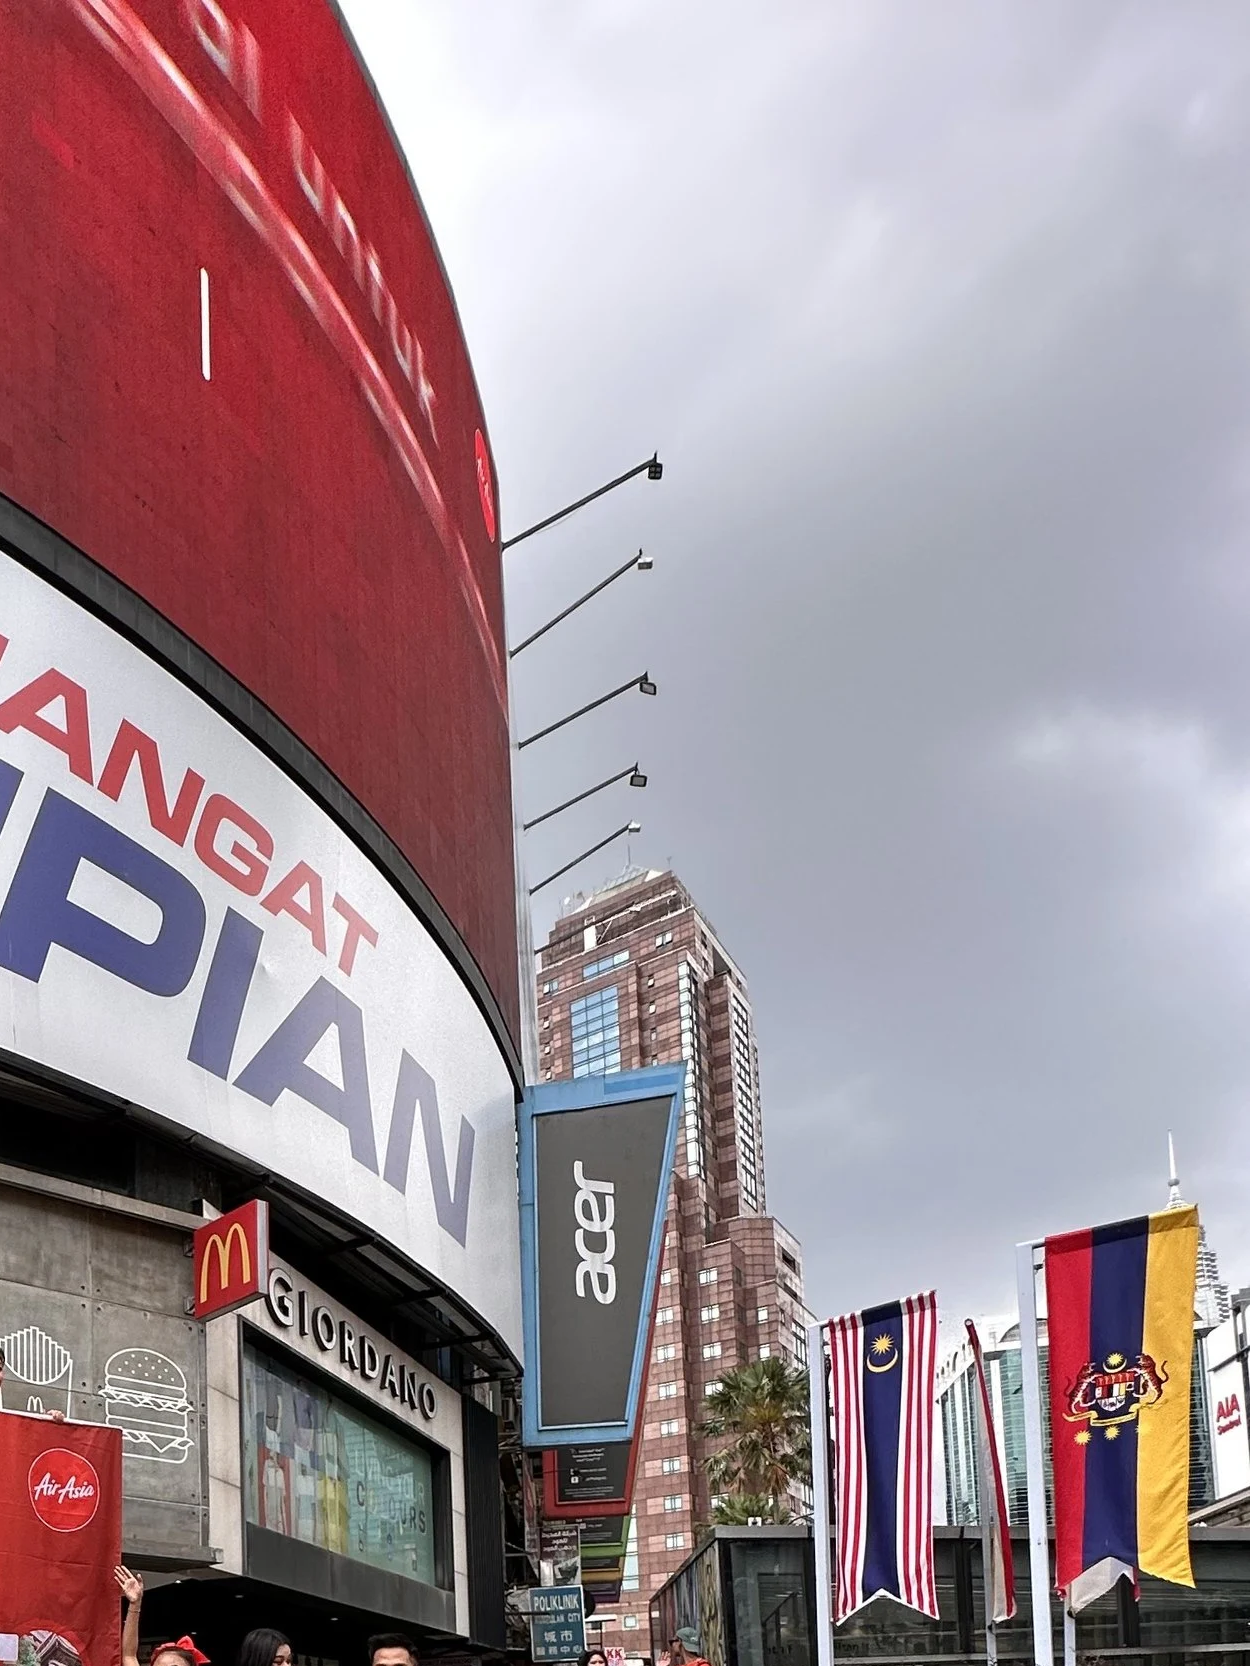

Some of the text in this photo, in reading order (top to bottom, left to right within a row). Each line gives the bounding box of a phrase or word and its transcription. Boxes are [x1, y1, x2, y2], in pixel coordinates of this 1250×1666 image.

[574, 1160, 616, 1304] acer
[268, 1267, 437, 1420] GIORDANO
[1216, 1394, 1241, 1422] AIA
[34, 1472, 95, 1504] AirAsia
[534, 1594, 579, 1611] POLIKLINIK
